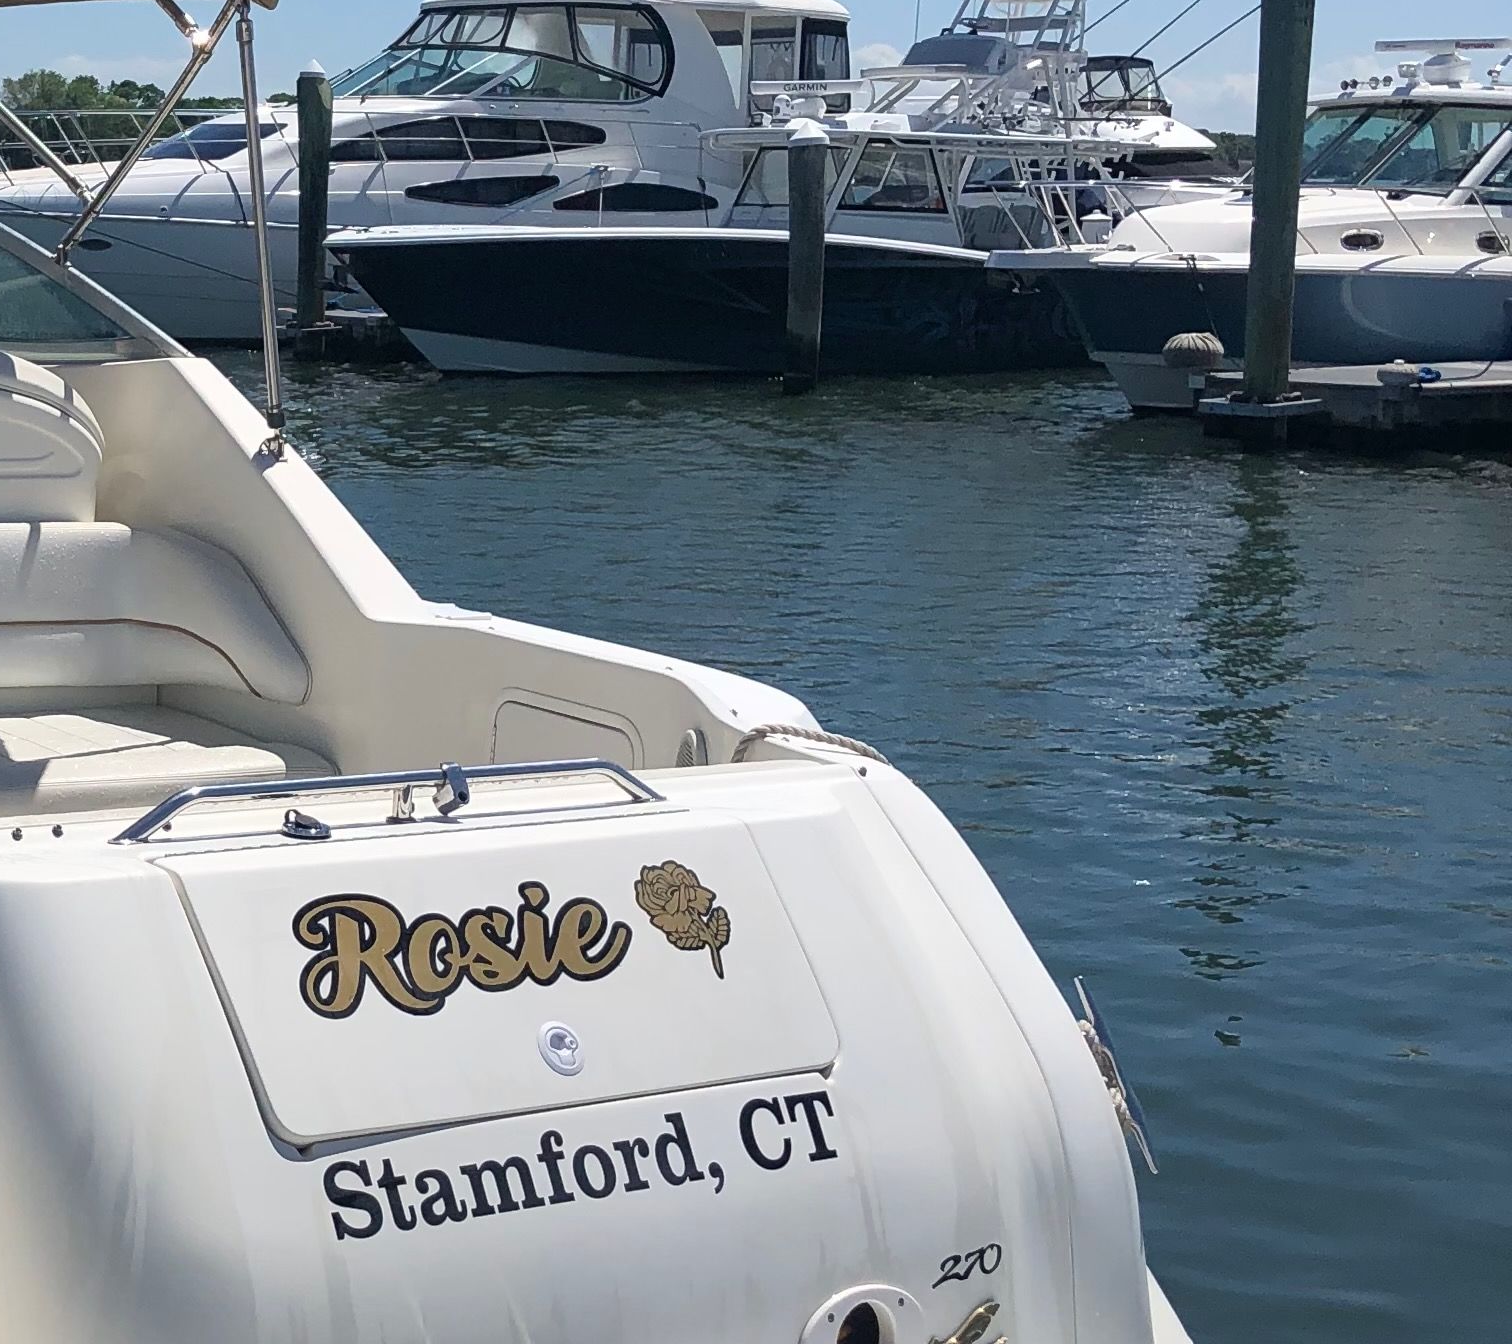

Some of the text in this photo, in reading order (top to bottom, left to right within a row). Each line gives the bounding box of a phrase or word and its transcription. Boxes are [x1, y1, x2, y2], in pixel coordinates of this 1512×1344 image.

[783, 83, 828, 92] GARMIN
[292, 881, 632, 1019] Rosie
[322, 1090, 839, 1241] Stamford, CT
[931, 1242, 1002, 1290] 270
